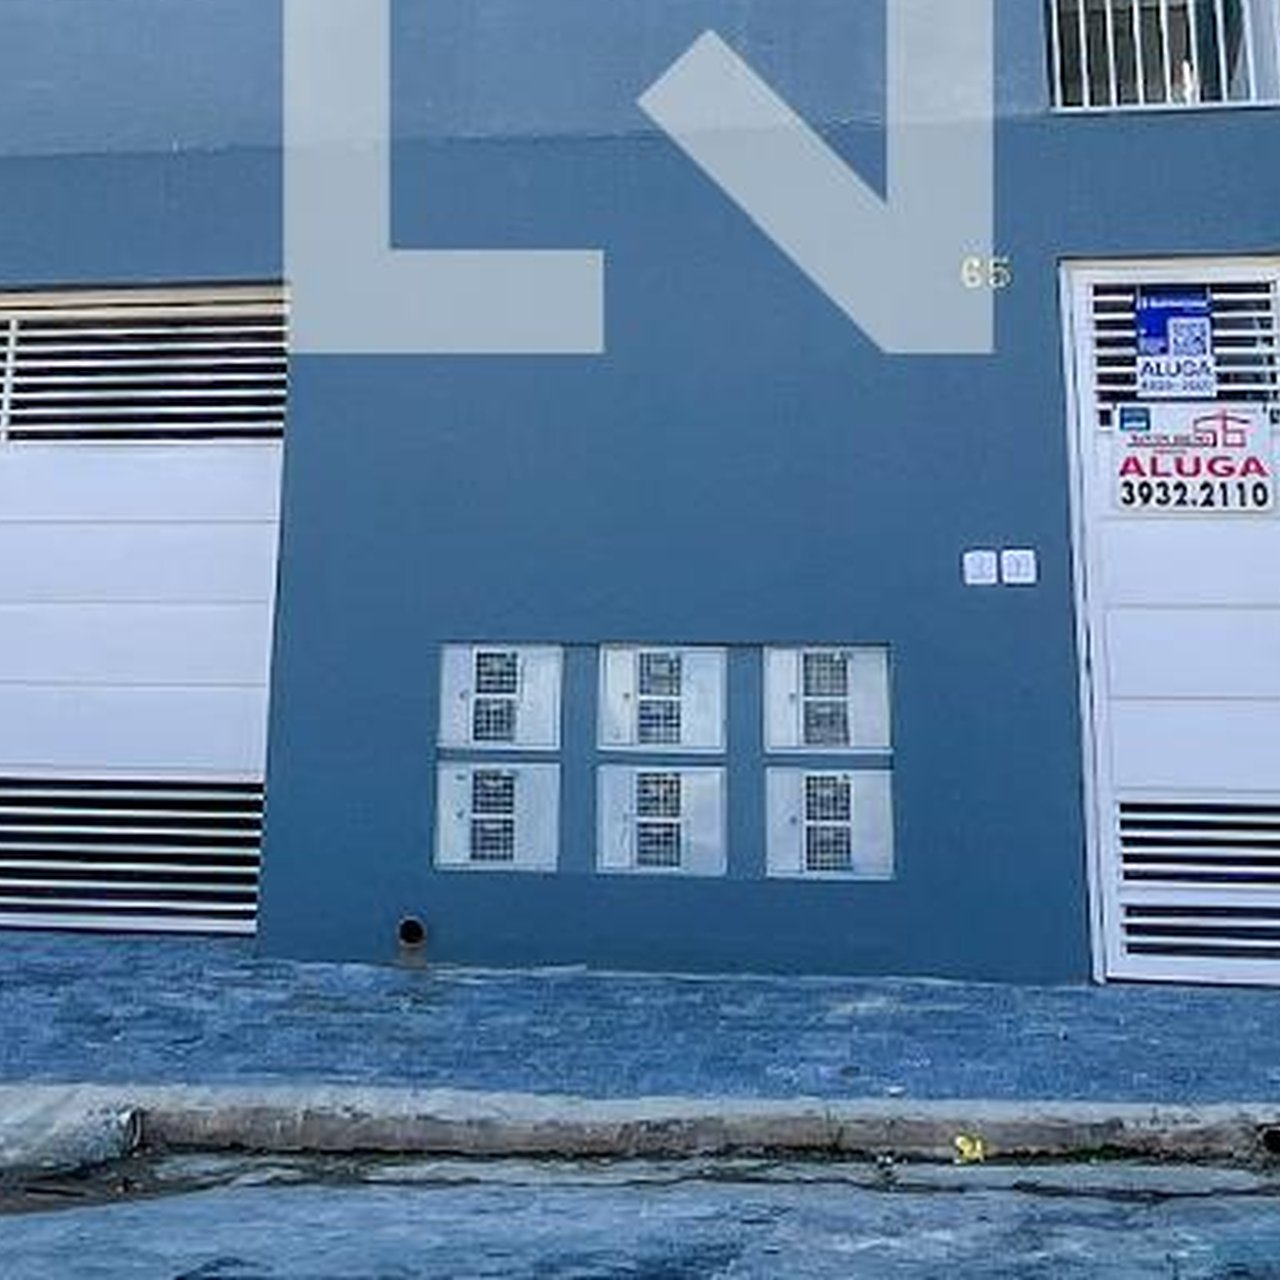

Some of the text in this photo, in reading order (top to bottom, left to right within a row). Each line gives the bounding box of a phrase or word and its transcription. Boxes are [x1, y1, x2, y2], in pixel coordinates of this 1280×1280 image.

[961, 256, 1012, 288] 65
[1139, 359, 1214, 378] ALUGA
[1119, 456, 1270, 477] ALUGA
[1121, 480, 1269, 508] 3932.2110
